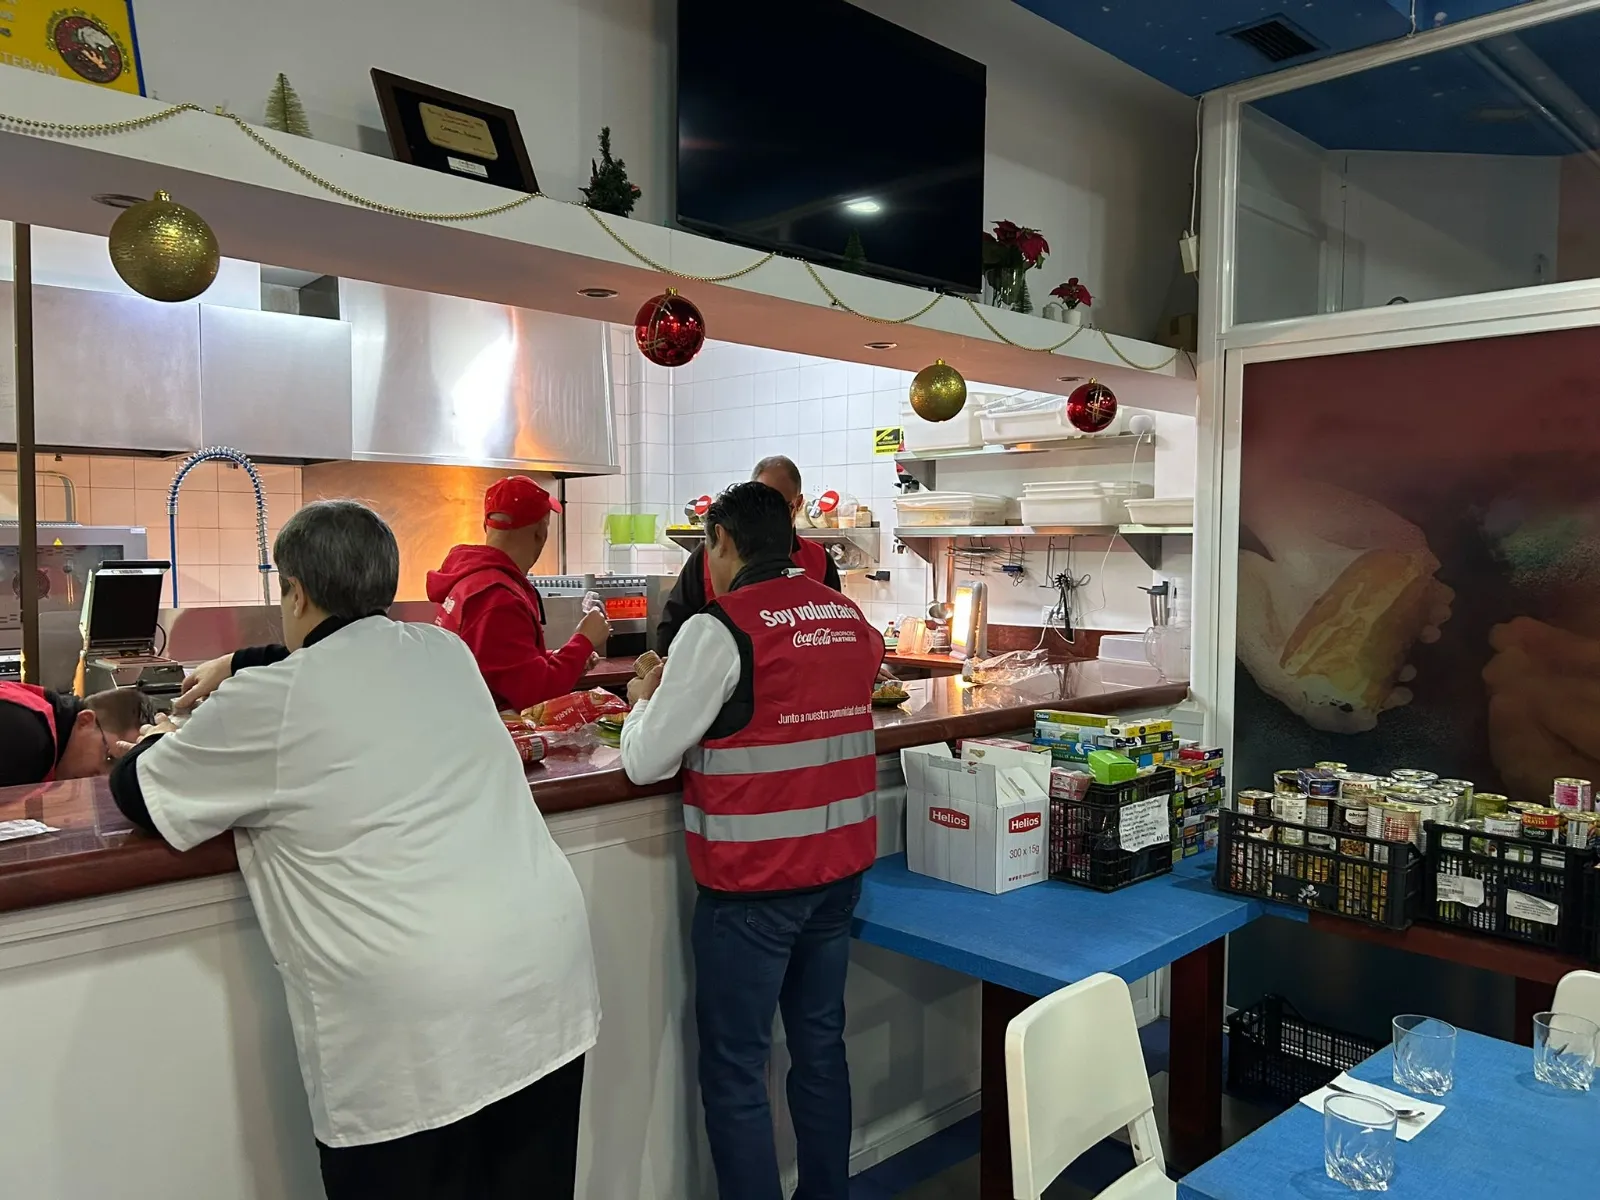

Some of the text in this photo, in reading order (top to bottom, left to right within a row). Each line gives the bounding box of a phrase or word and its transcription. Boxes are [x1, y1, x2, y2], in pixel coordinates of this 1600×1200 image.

[759, 608, 796, 627] Soy
[778, 713, 800, 724] Junto
[800, 714, 805, 722] a
[932, 810, 967, 826] Helios
[1011, 817, 1039, 830] Helios
[1009, 848, 1021, 859] 300
